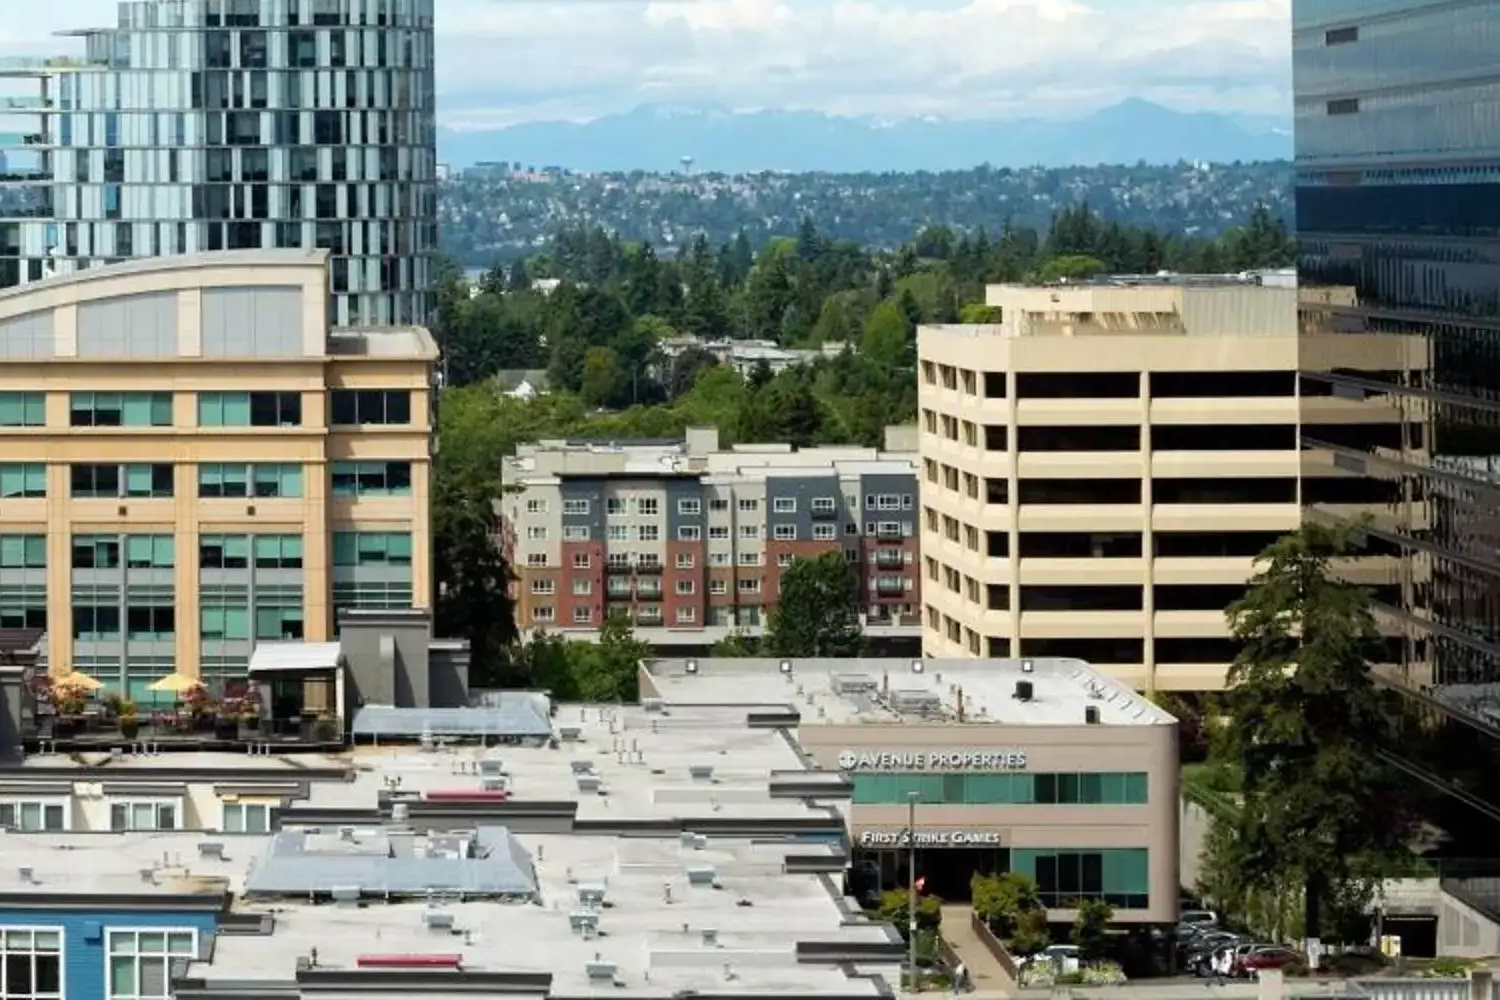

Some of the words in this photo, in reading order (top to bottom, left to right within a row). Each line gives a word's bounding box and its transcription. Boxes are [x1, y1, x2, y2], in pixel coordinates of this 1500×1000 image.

[859, 752, 924, 767] AVENUE
[929, 752, 1027, 768] PROPERTIES
[861, 831, 898, 844] FIRST
[951, 831, 1000, 844] GAMES
